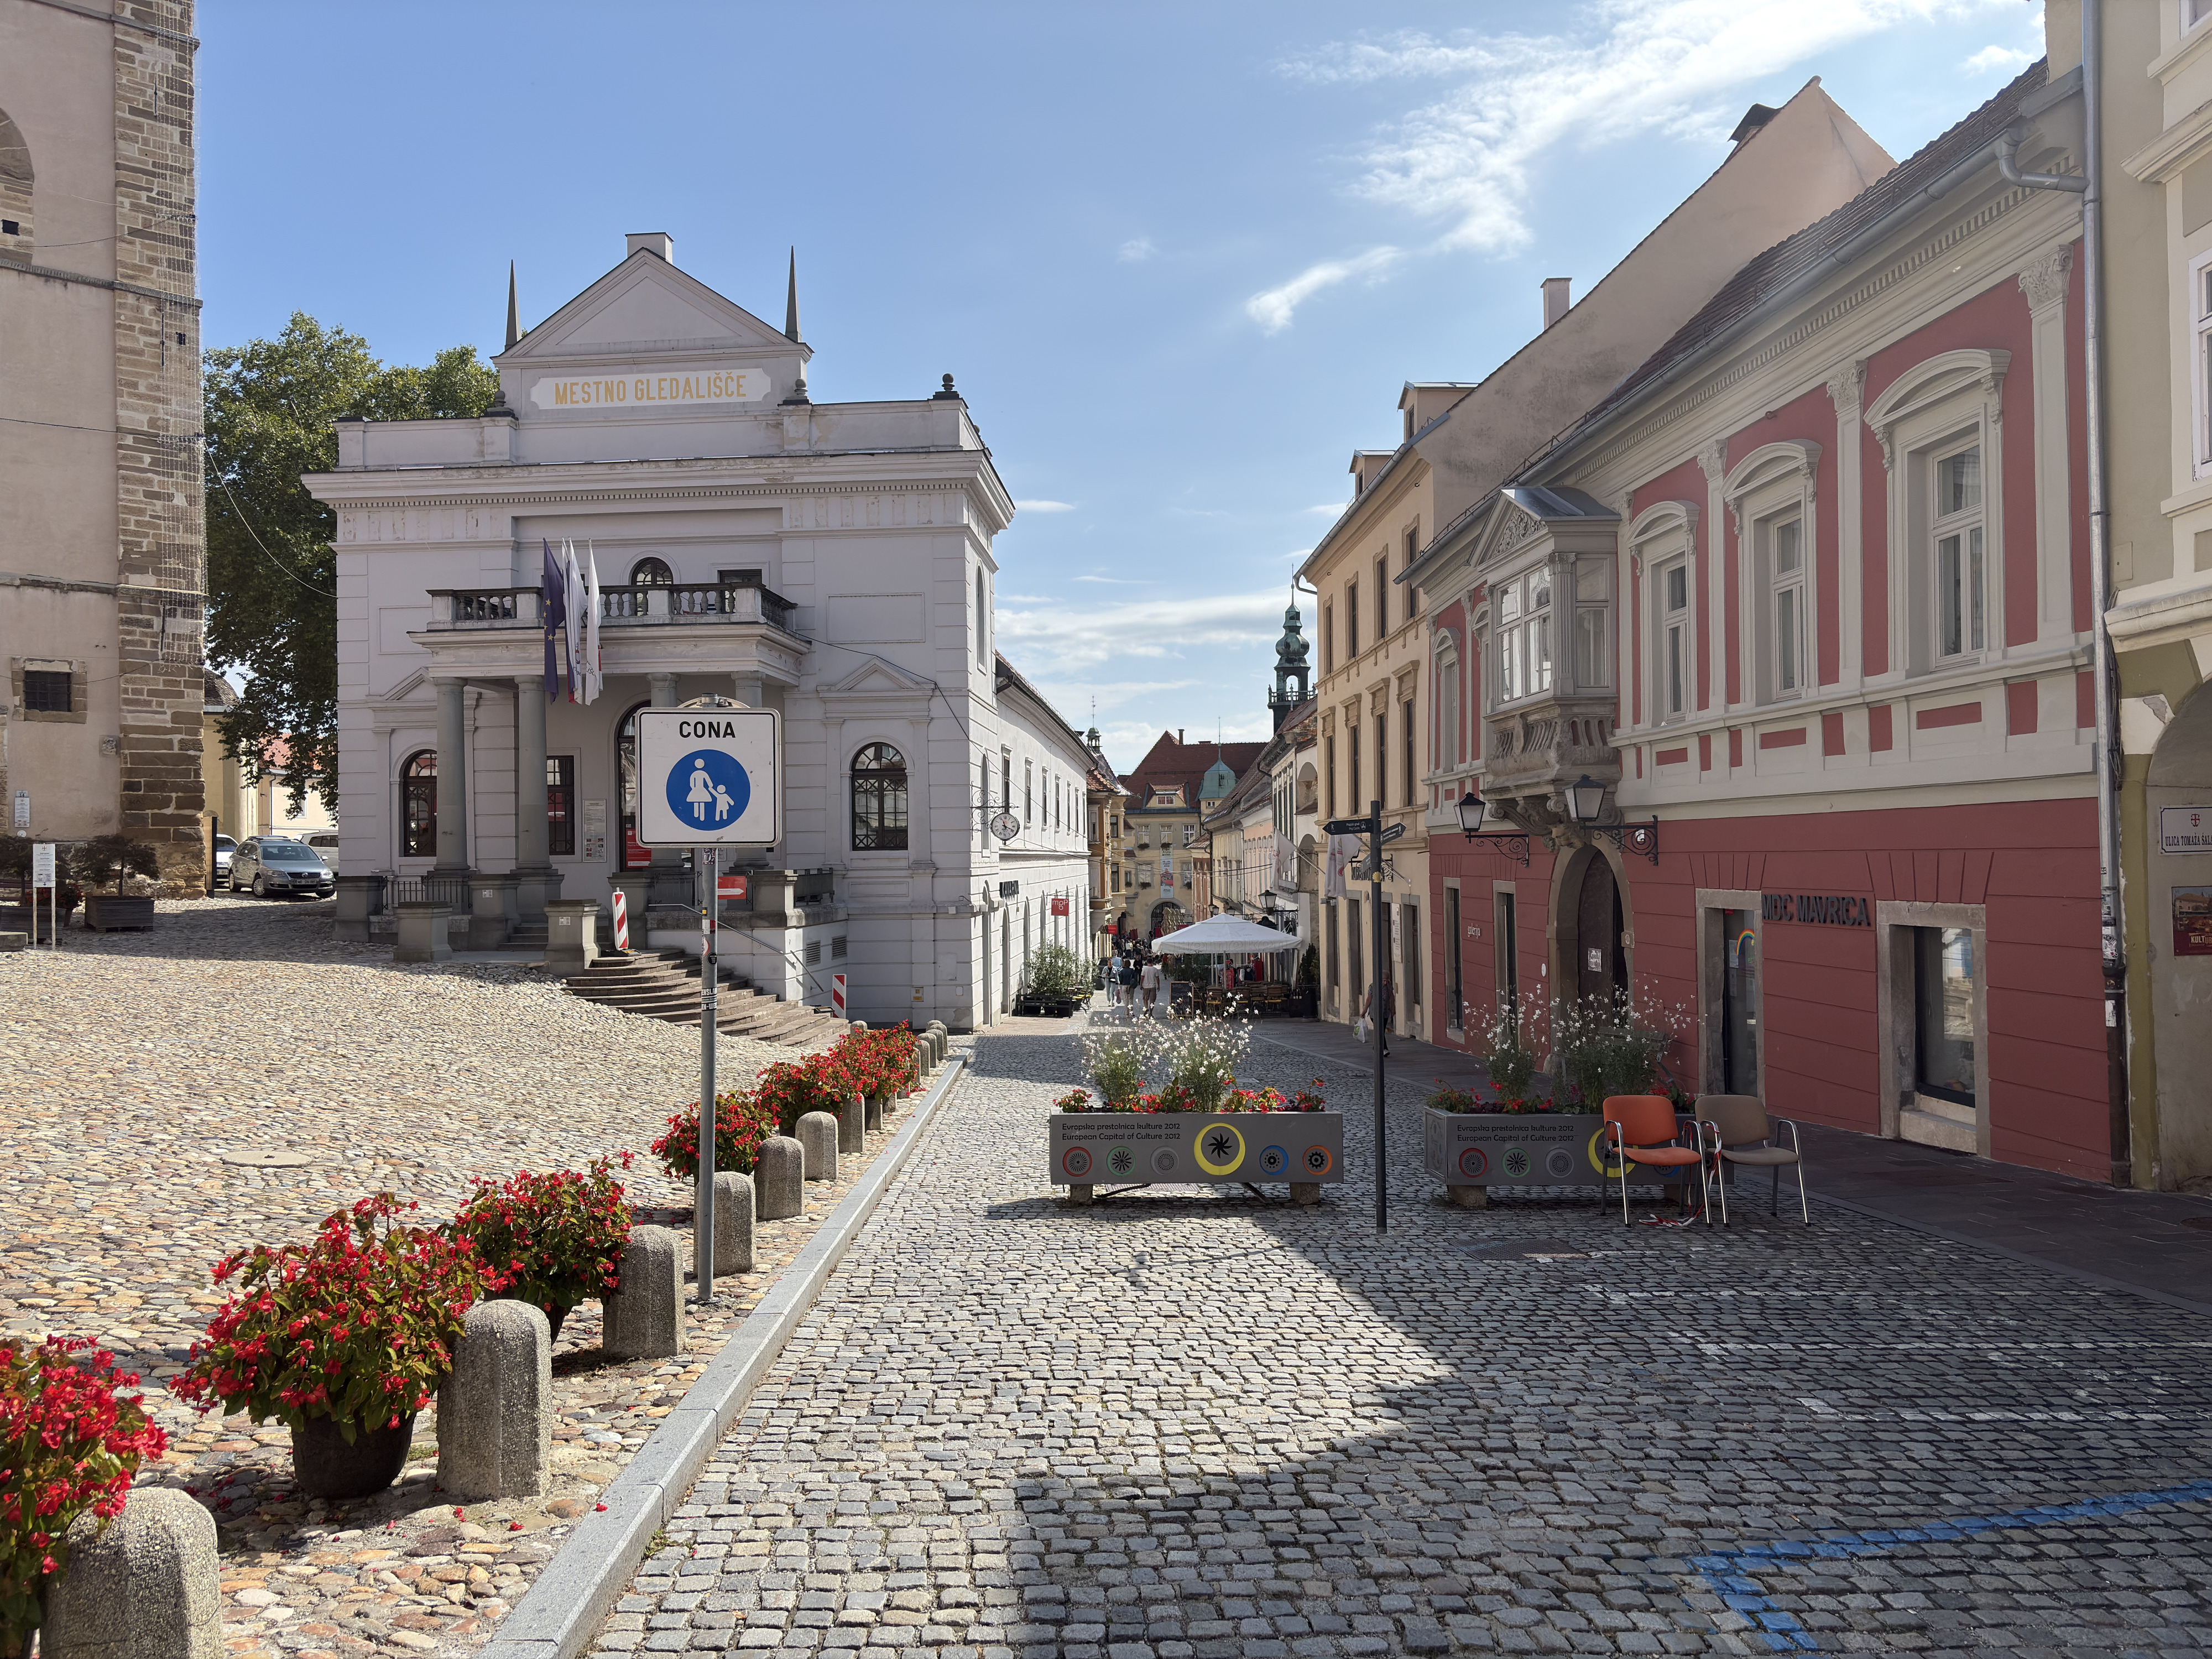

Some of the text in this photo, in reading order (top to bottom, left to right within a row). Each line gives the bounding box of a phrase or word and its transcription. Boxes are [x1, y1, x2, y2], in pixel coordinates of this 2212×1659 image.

[555, 371, 747, 405] MESTNO GLEDALIŠČE
[679, 721, 736, 738] CONA
[2165, 836, 2180, 846] ULICA
[1761, 894, 1870, 927] MDC MAVRICA
[1468, 923, 1480, 938] galerija
[1062, 1123, 1095, 1131] Evropska
